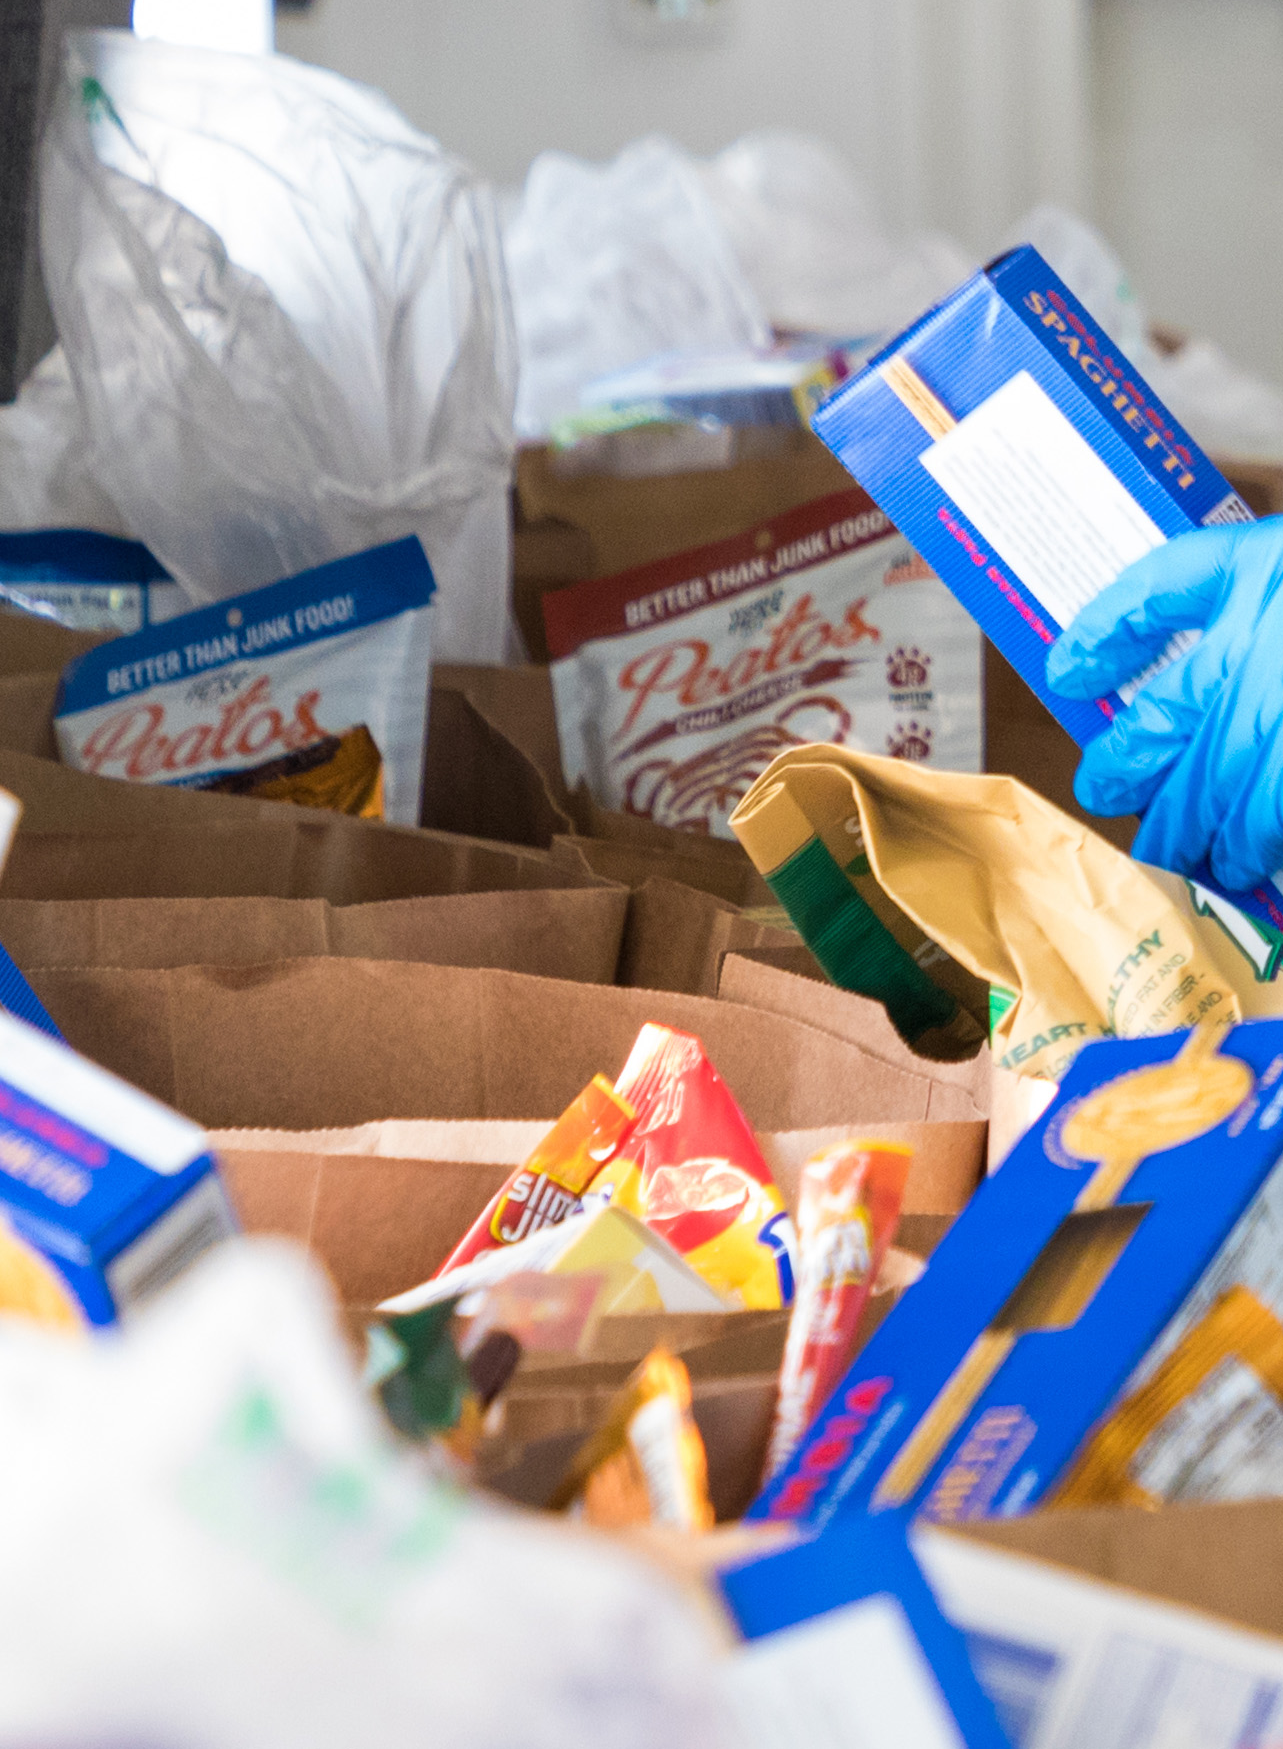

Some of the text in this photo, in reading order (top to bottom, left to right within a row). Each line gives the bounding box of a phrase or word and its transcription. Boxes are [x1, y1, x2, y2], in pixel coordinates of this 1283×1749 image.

[1022, 291, 1196, 491] SPAGHETTI
[625, 578, 709, 628] BETTER
[707, 557, 767, 597] THAN
[769, 533, 827, 575] JUNK
[107, 651, 183, 695] BETTER
[184, 632, 240, 671] THAN
[241, 611, 294, 653] JUNK
[294, 593, 355, 635] FOOD!
[1157, 953, 1187, 979] AND
[1197, 990, 1224, 1014] AND
